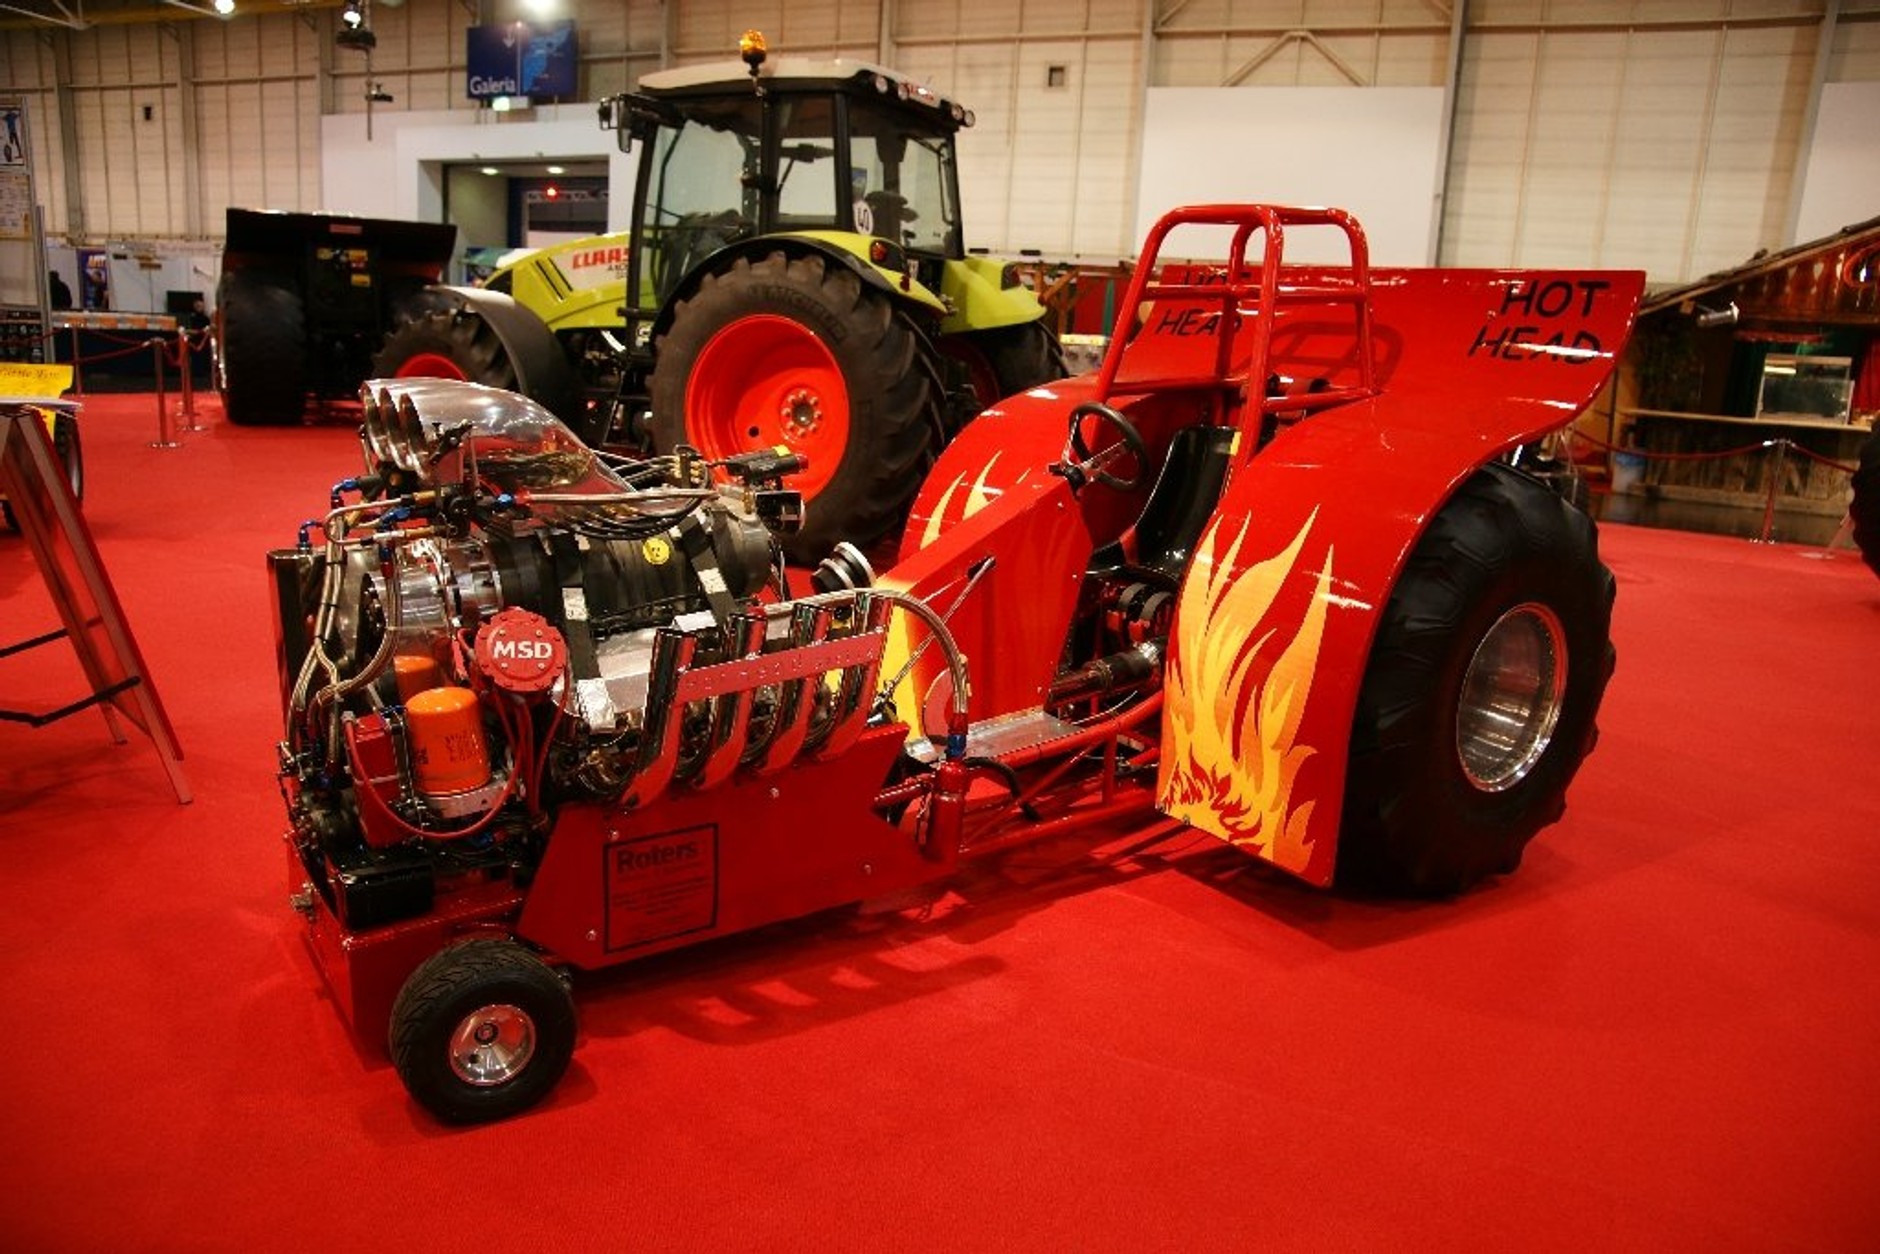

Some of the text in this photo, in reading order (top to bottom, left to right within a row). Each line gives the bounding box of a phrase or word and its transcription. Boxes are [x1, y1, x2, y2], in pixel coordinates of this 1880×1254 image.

[469, 75, 516, 95] Galeria
[1500, 279, 1611, 318] HOT
[1467, 325, 1603, 365] HEAD
[493, 640, 553, 660] MSD
[616, 841, 699, 875] Roters
